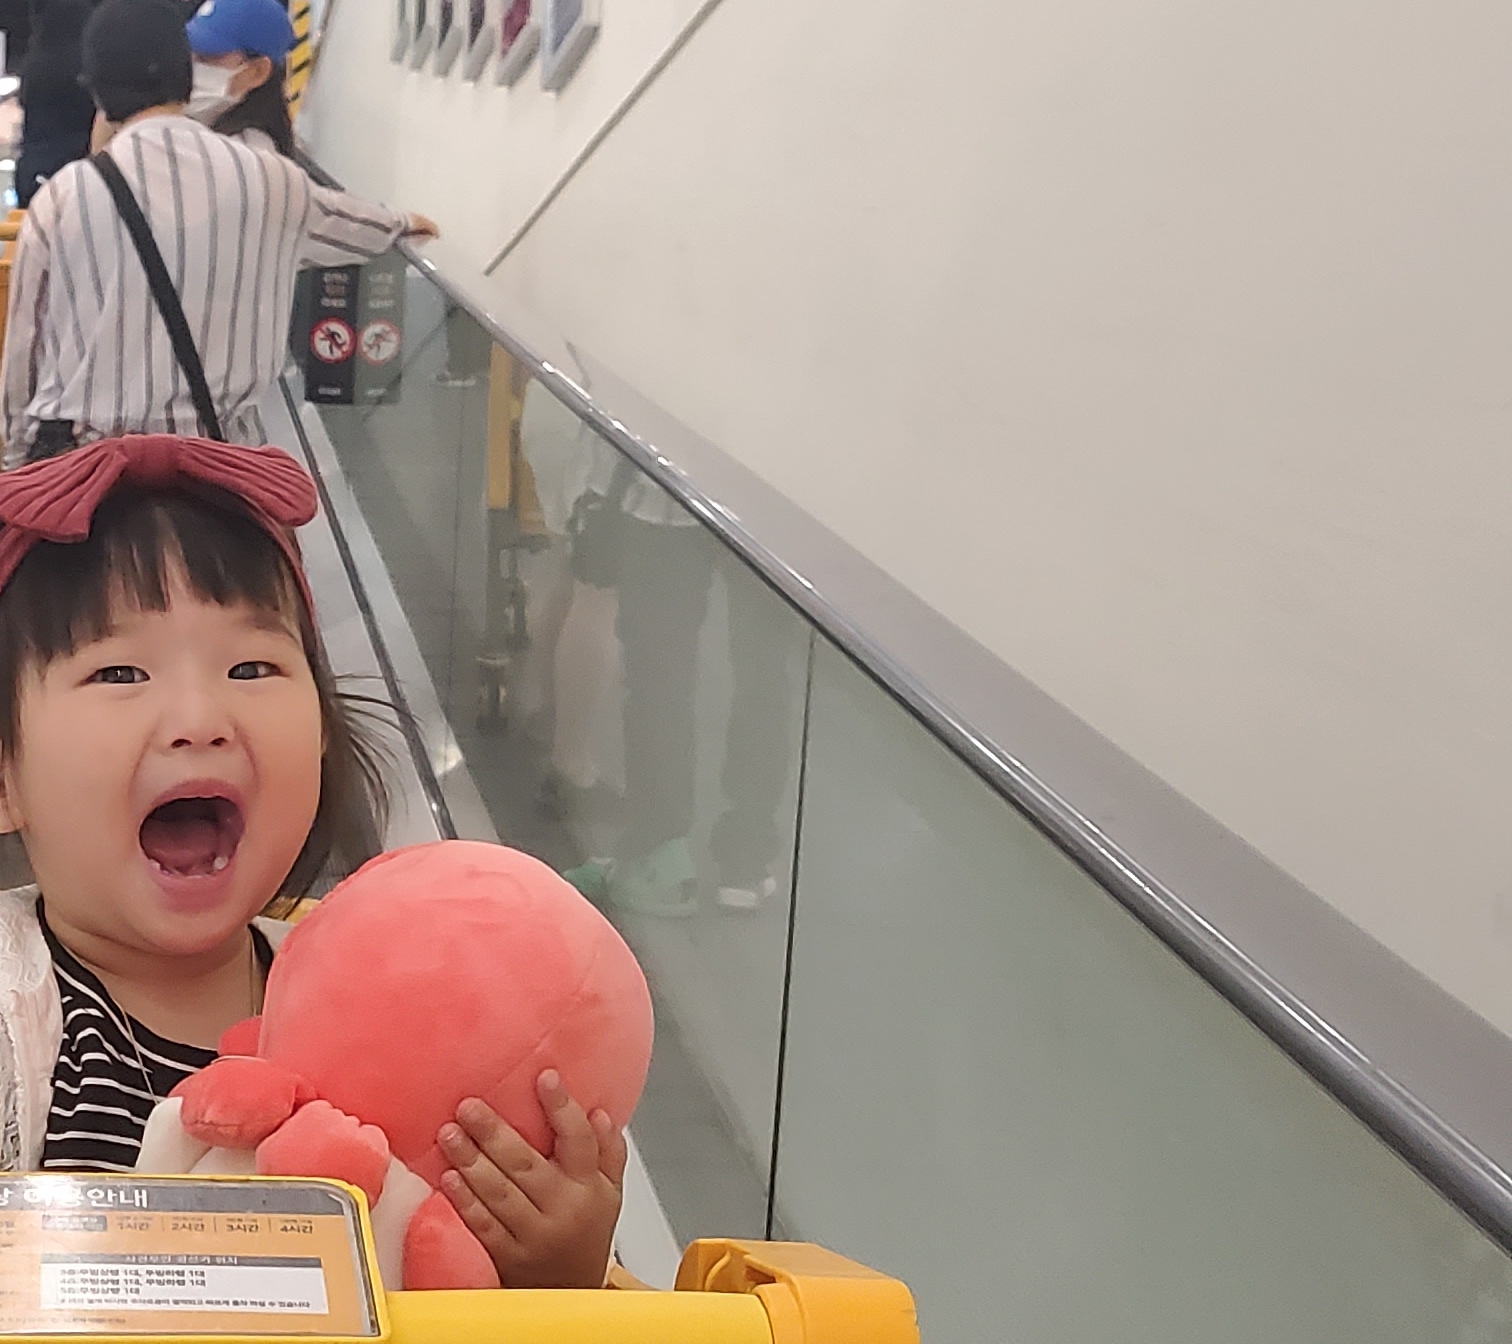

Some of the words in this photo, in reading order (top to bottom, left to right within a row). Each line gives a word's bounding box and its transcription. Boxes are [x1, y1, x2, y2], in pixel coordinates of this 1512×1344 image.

[117, 1222, 149, 1231] 1시간
[171, 1222, 205, 1232] 2시간
[226, 1223, 259, 1233] 3시간
[280, 1224, 313, 1234] 4시간
